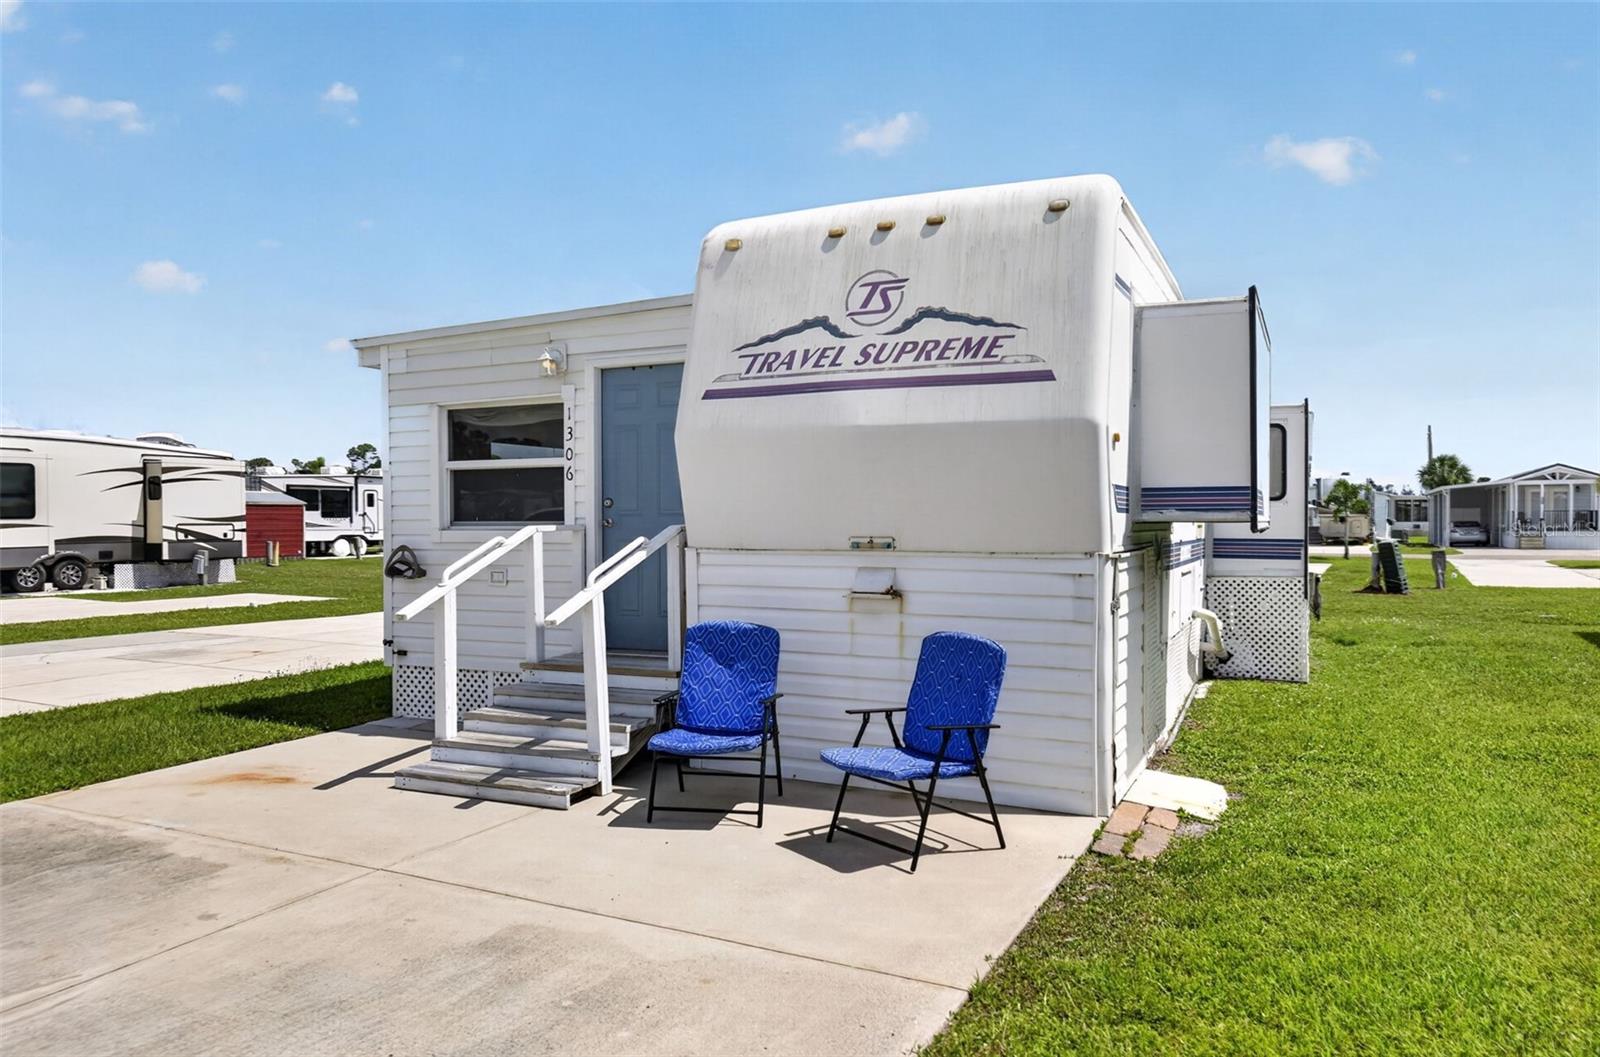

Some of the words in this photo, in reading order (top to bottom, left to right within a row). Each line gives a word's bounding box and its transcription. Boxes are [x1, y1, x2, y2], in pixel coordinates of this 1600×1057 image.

[846, 278, 910, 317] TS
[738, 345, 845, 375] TRAVEL
[854, 334, 1016, 366] SUPREME
[565, 407, 574, 481] 1306
